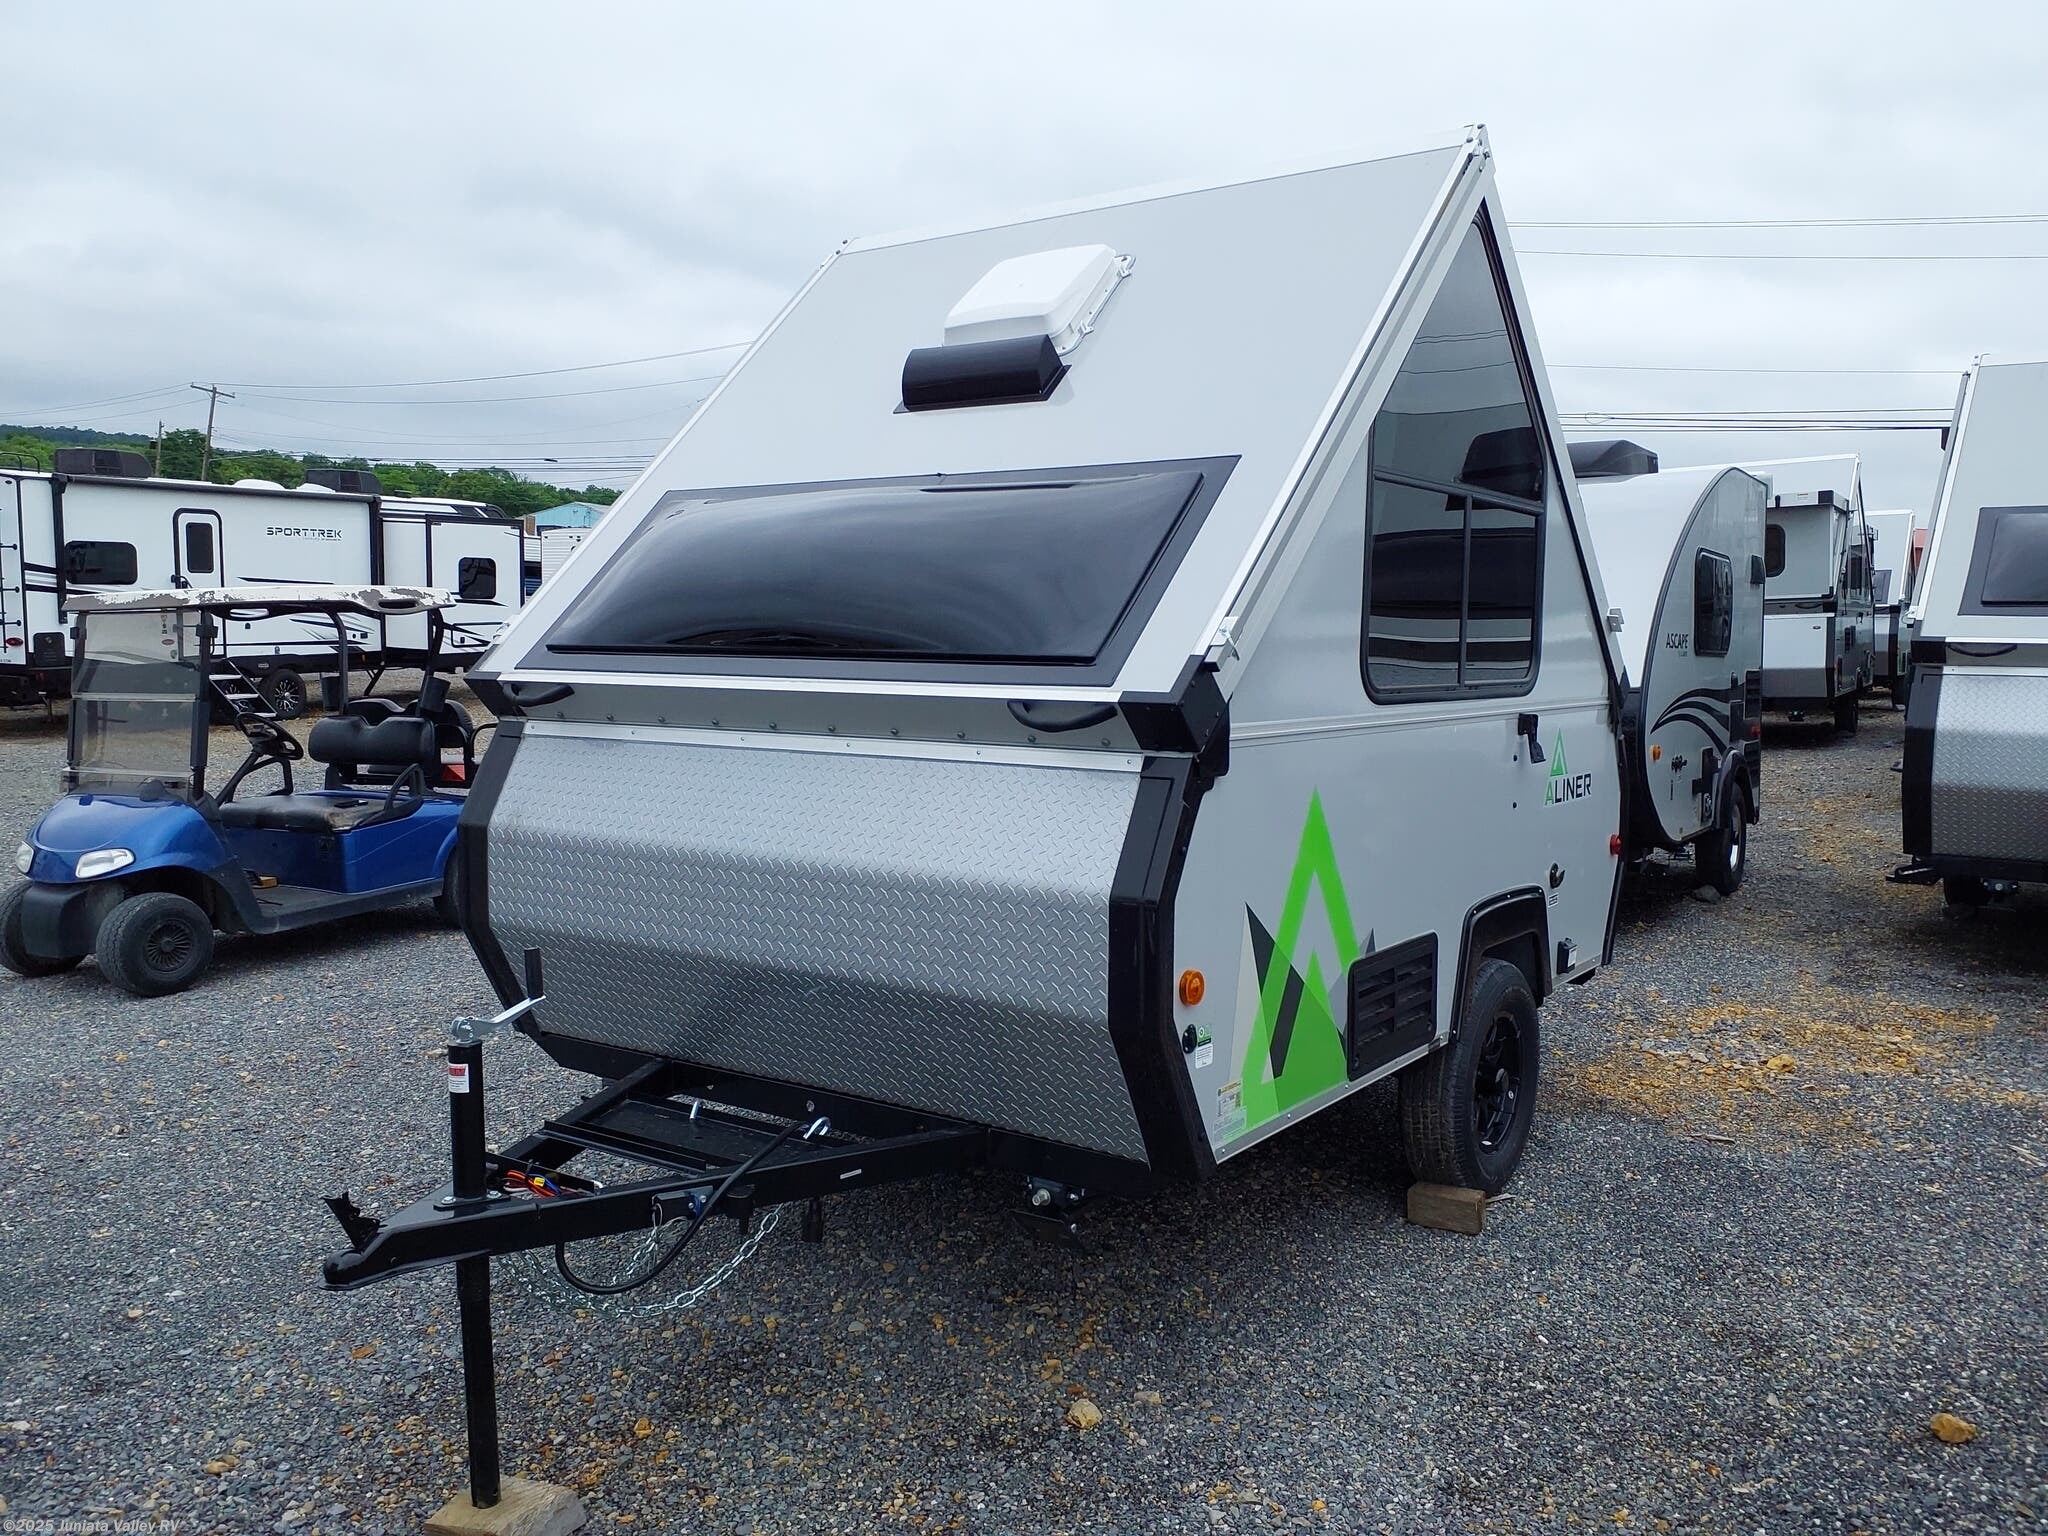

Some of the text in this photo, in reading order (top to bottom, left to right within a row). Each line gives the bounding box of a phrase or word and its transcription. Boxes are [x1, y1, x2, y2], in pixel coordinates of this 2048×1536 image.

[266, 526, 342, 539] SPORTTREK
[1665, 632, 1689, 649] ASCAPE
[1544, 773, 1592, 806] ALINER
